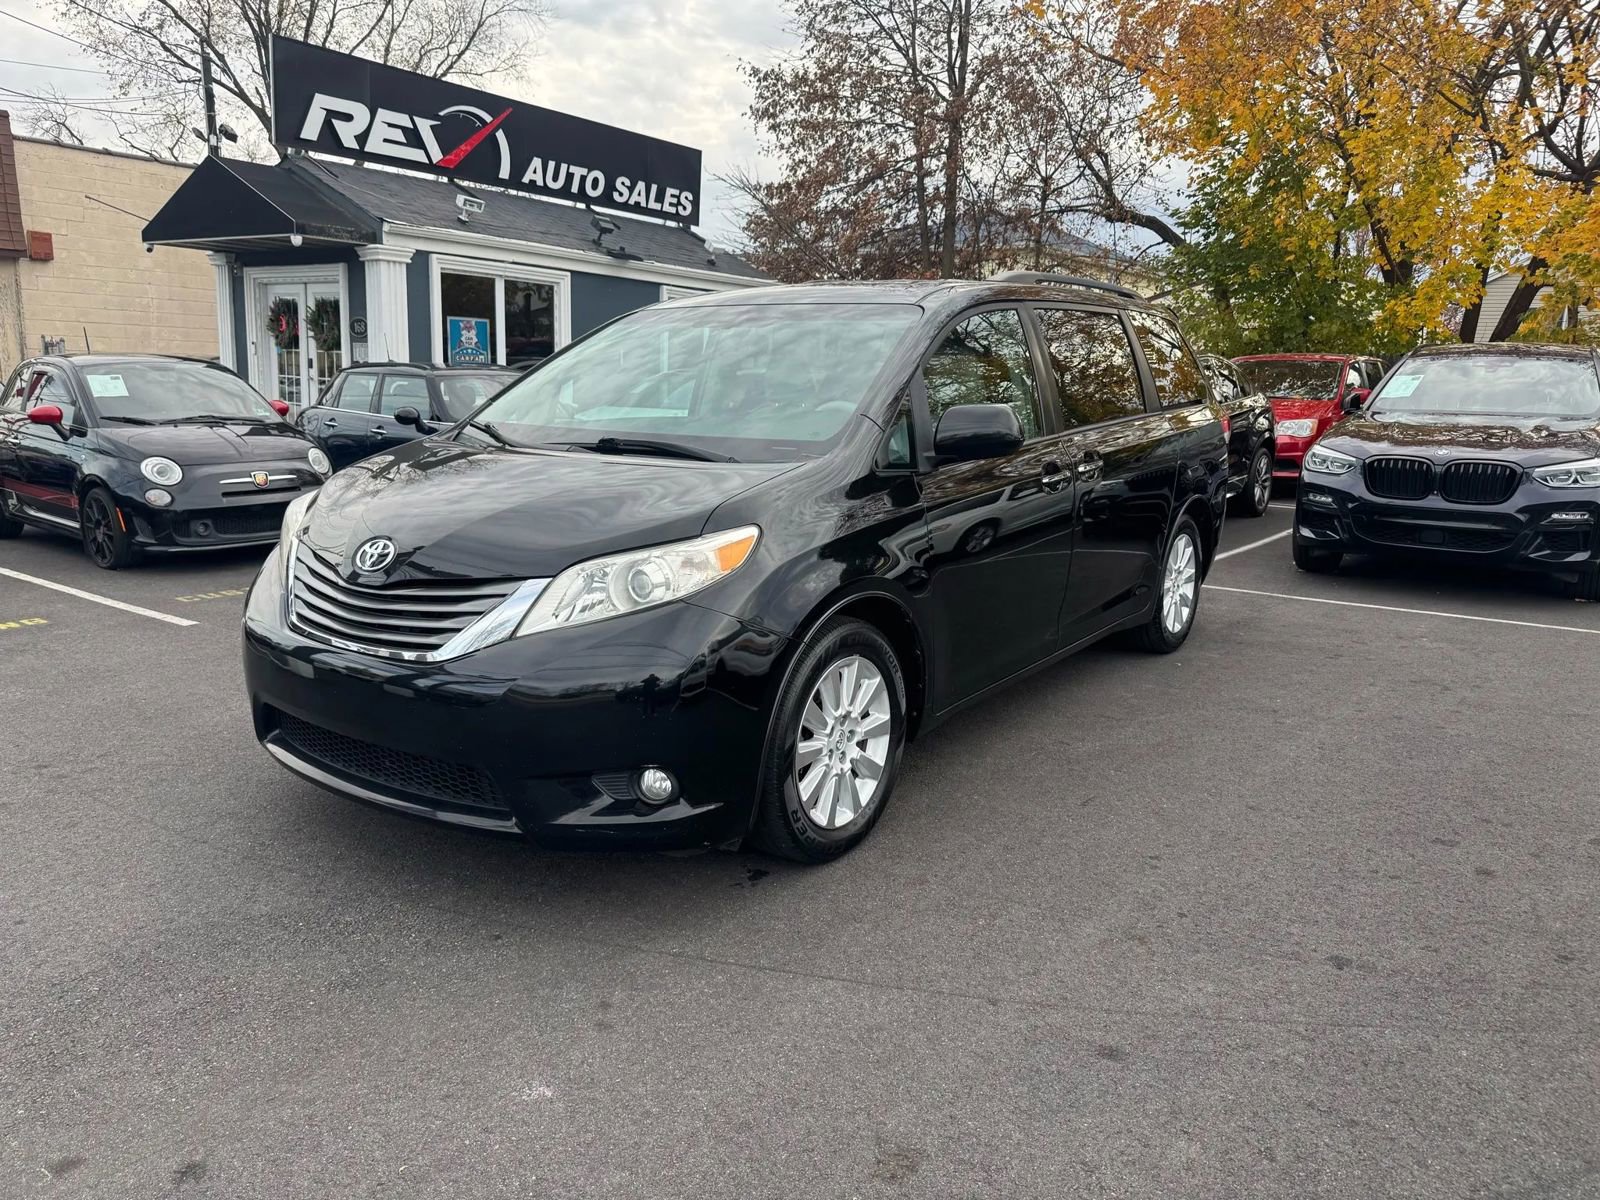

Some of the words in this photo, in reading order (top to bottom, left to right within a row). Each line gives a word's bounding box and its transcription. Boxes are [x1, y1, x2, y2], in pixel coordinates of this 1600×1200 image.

[299, 92, 514, 169] REX
[521, 156, 605, 198] AUTO
[612, 176, 693, 217] SALES
